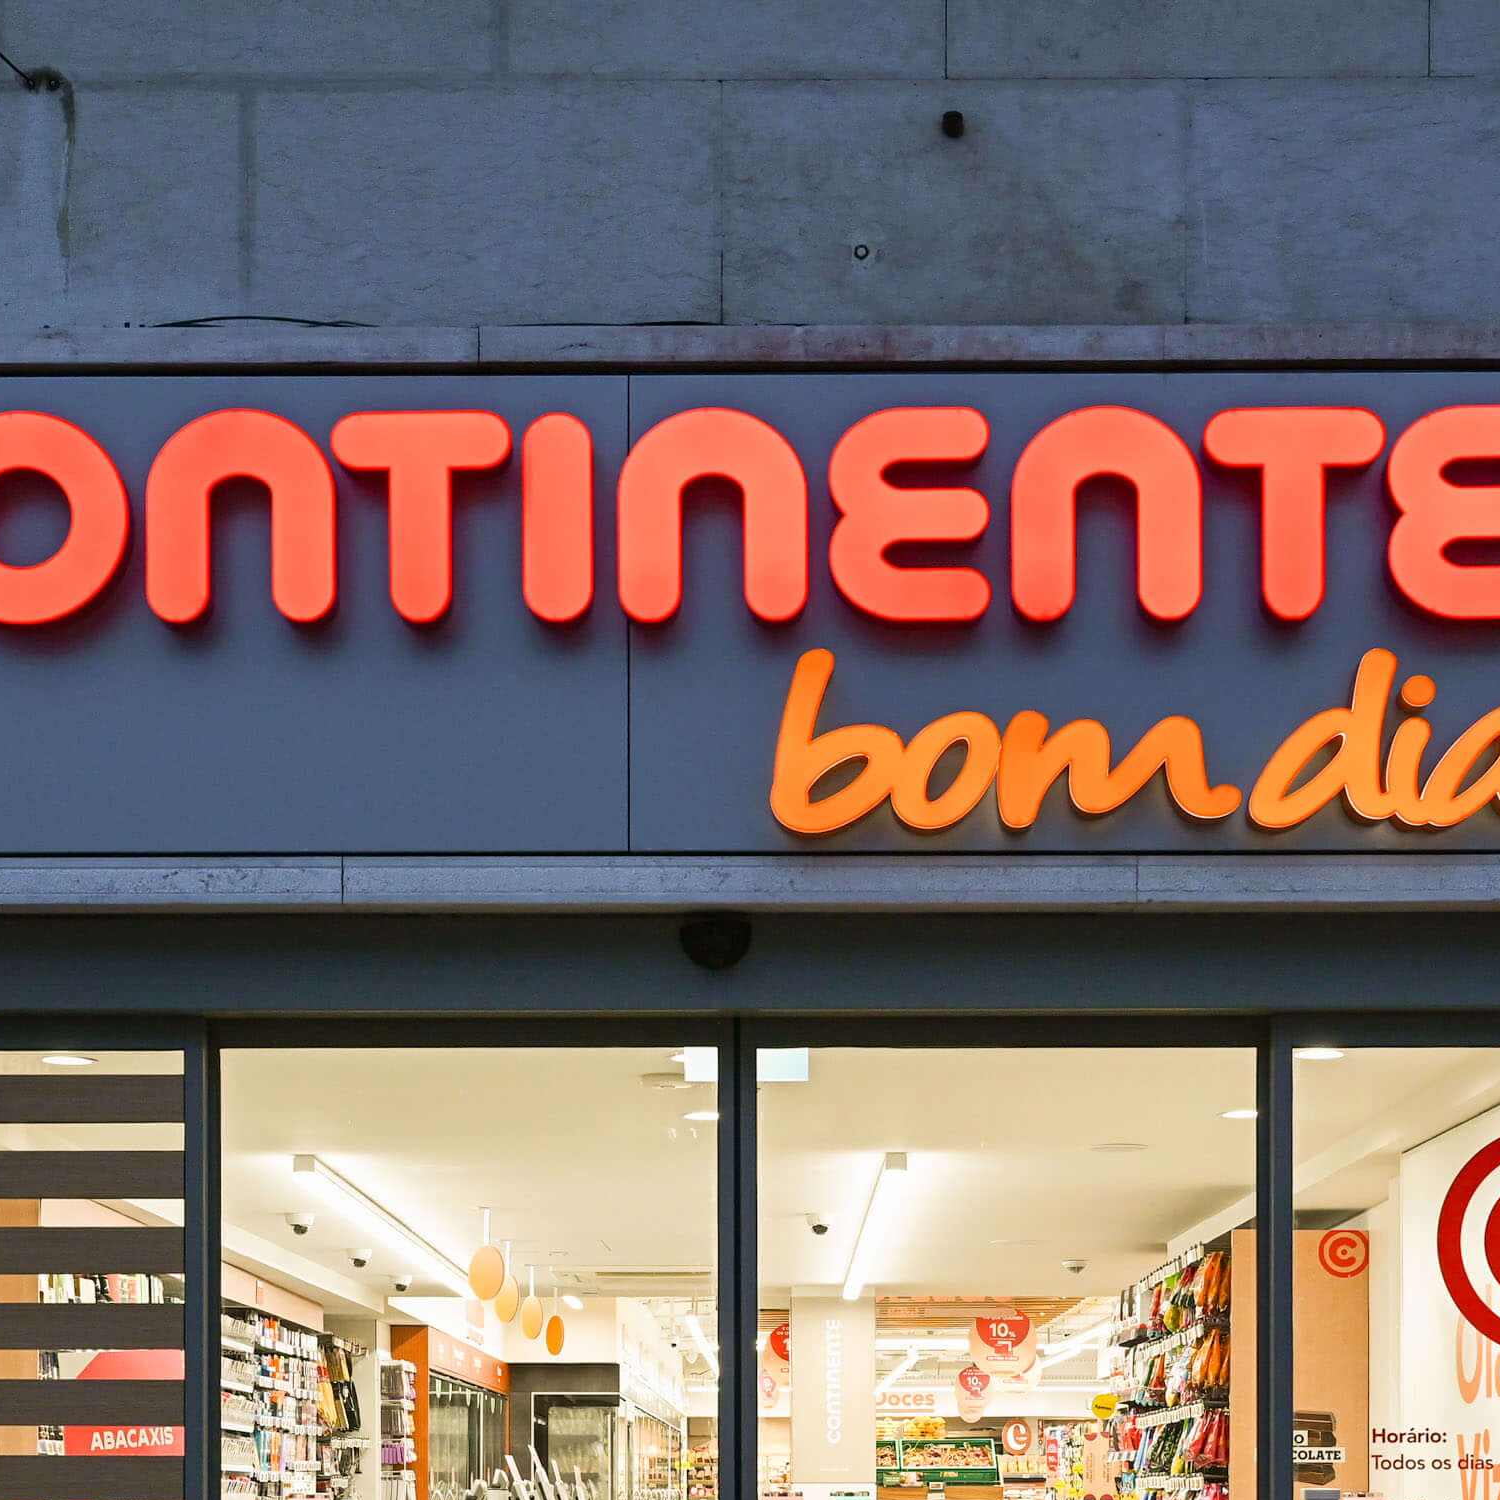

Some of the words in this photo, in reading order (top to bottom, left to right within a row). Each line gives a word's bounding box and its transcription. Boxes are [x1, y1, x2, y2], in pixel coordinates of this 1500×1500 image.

[769, 648, 1243, 834] bom
[826, 1319, 842, 1445] CONTINENTE
[90, 1426, 174, 1451] ABACAXIS
[1371, 1428, 1447, 1444] Horário:
[1372, 1454, 1425, 1470] Todos
[1431, 1458, 1451, 1470] os
[1458, 1454, 1494, 1470] dias
